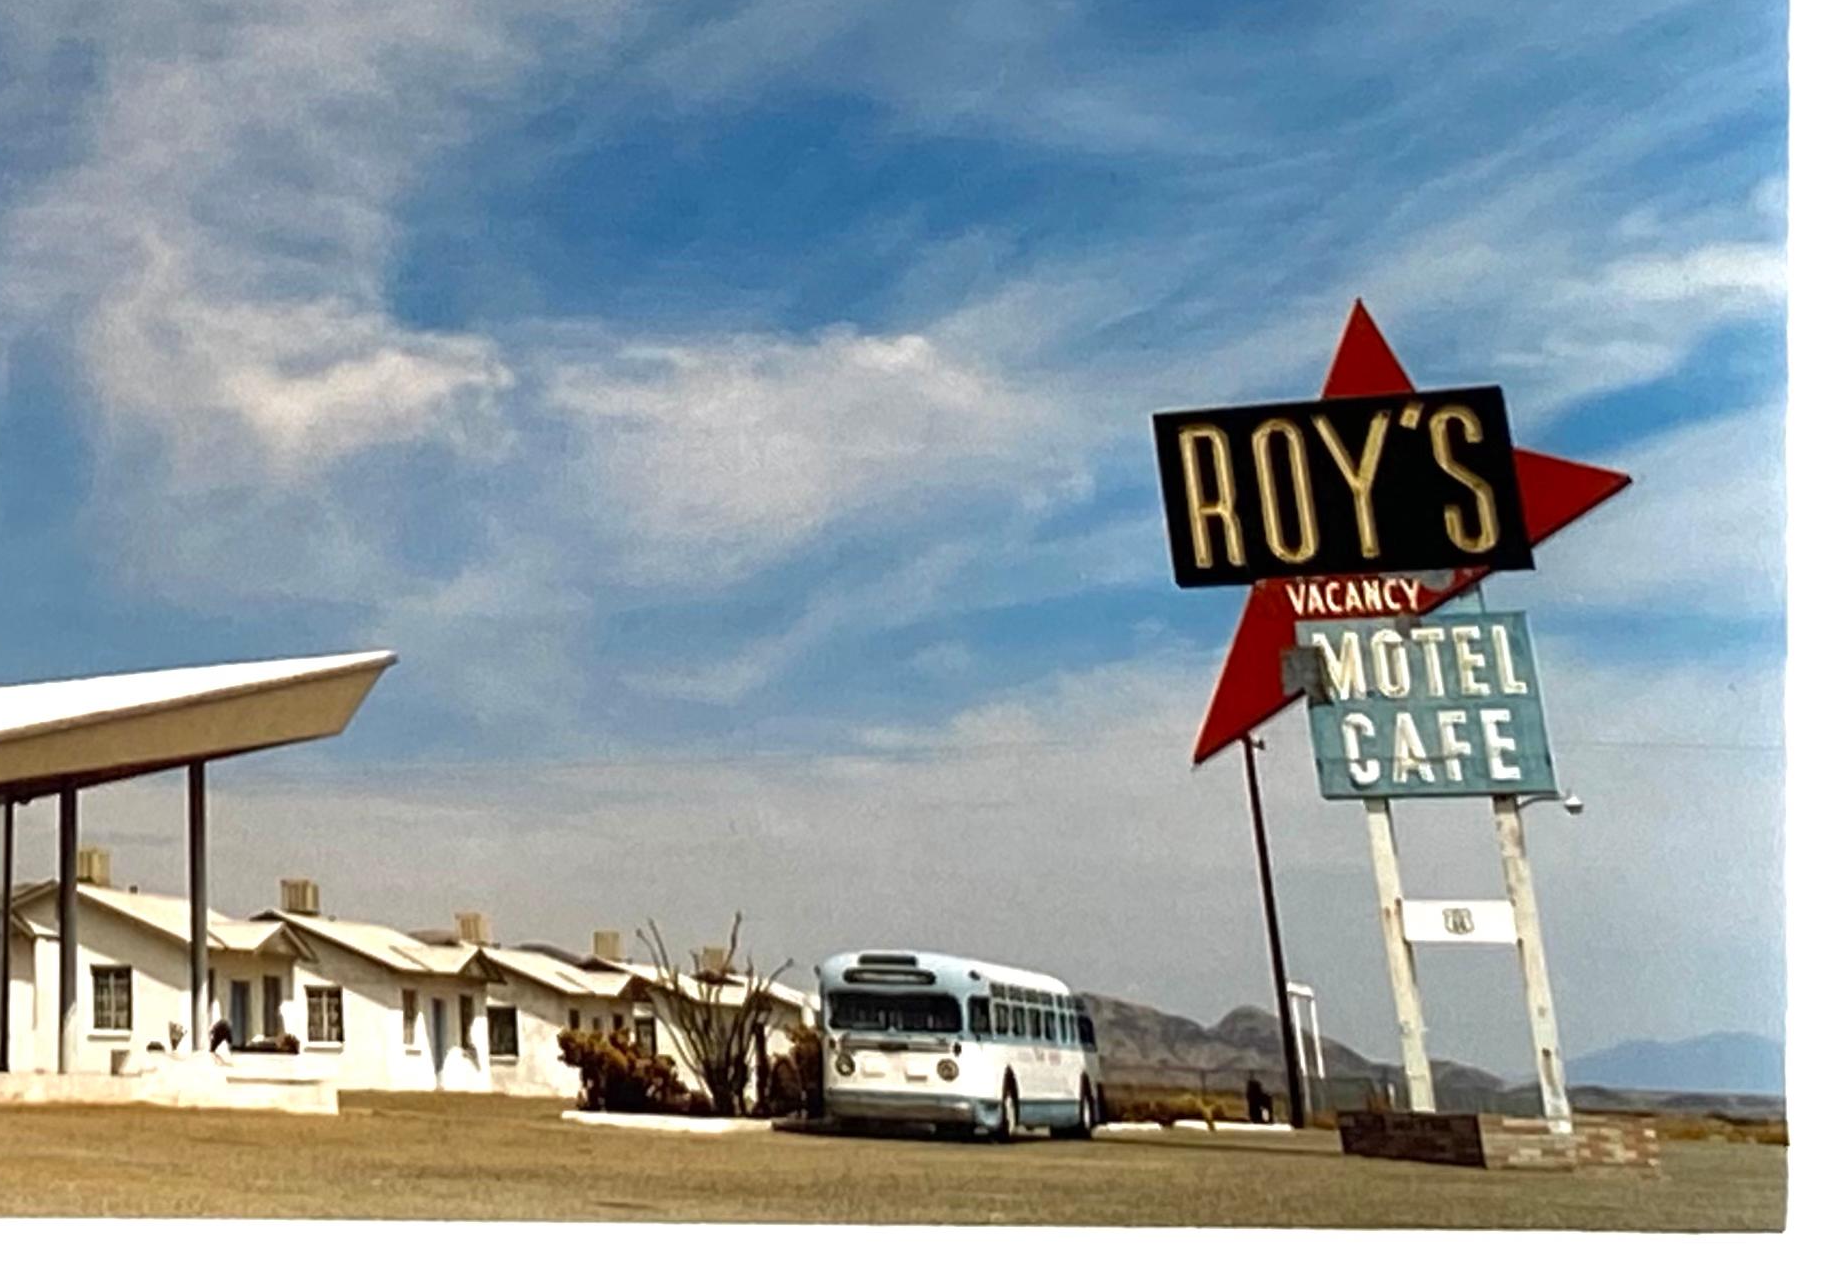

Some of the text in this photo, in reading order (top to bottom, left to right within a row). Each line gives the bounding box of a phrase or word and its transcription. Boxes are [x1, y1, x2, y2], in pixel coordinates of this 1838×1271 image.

[1178, 403, 1498, 569] ROY'S
[1286, 578, 1422, 616] VACANCY
[1312, 625, 1528, 701] MOTEL
[1341, 709, 1522, 785] CAFE
